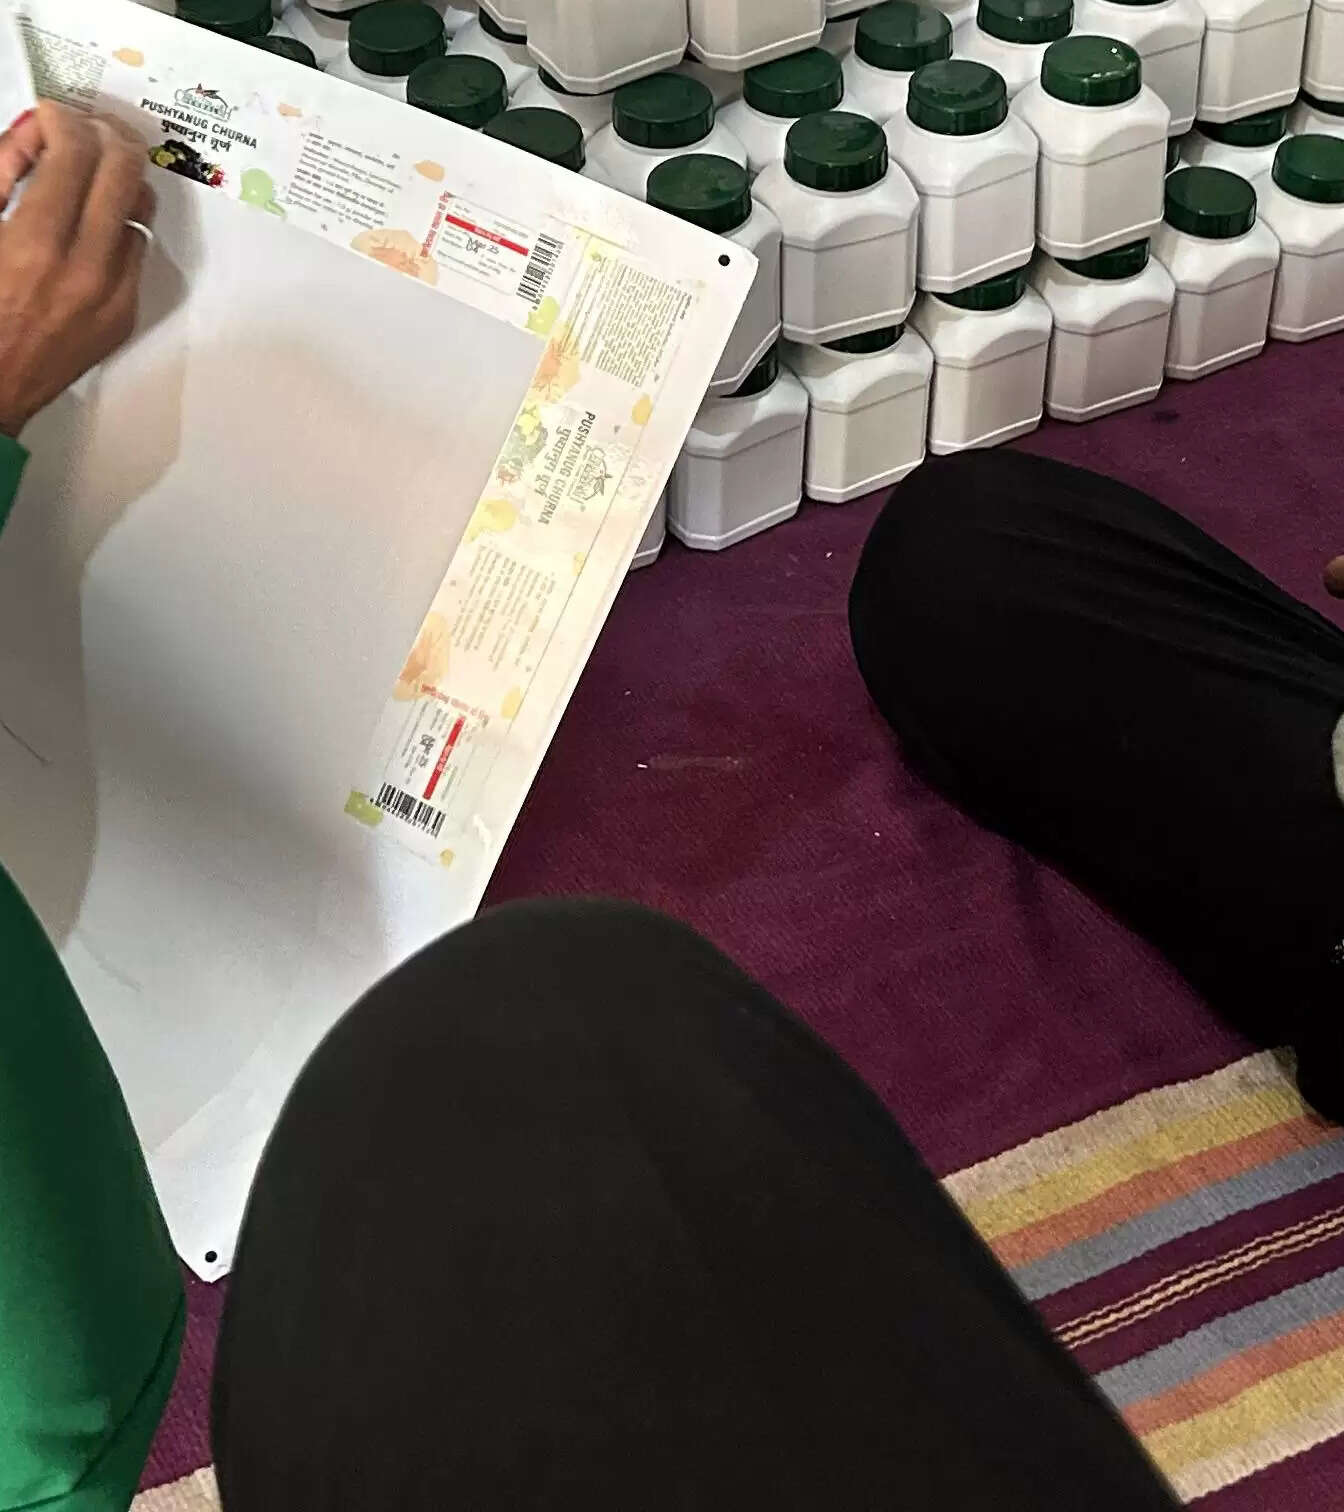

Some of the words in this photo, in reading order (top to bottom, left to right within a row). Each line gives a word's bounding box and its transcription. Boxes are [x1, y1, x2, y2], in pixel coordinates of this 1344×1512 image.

[140, 98, 209, 129] PUSHYANUG
[211, 123, 258, 149] CHURNA
[559, 410, 596, 477] PUSHYANUG
[538, 478, 567, 525] CHURNA
